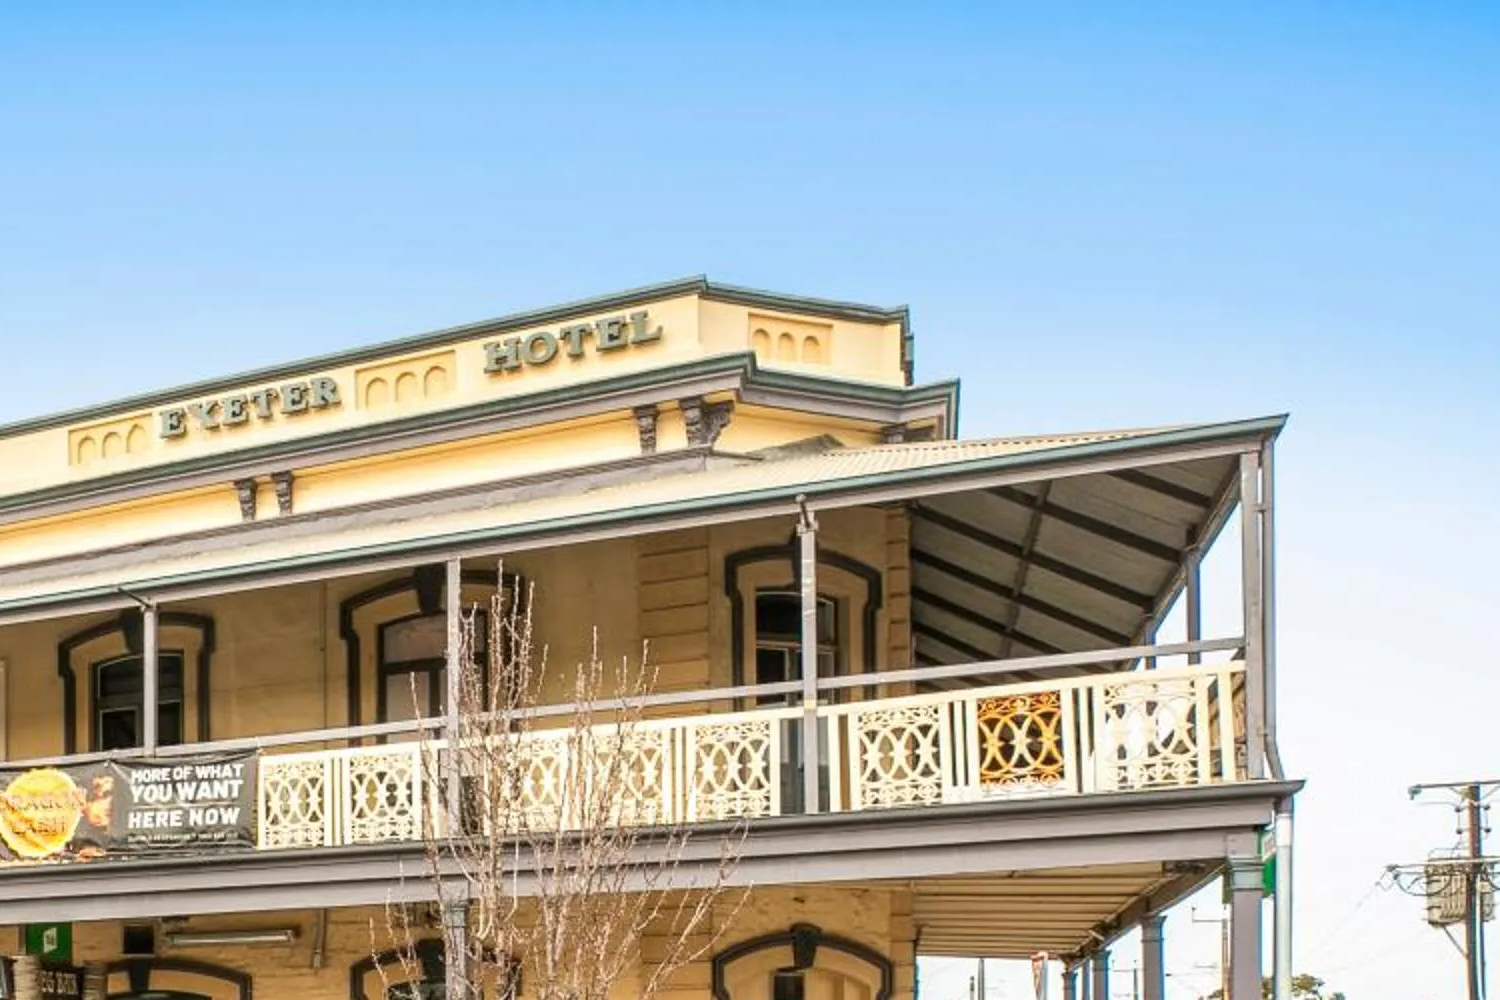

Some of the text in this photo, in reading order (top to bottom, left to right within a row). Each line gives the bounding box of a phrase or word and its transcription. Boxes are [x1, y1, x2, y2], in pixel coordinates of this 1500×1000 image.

[483, 311, 663, 374] HOTEL
[131, 763, 244, 784] MORE OF WHAT
[130, 779, 244, 803] YOU WANT
[128, 807, 241, 828] HERE NOW
